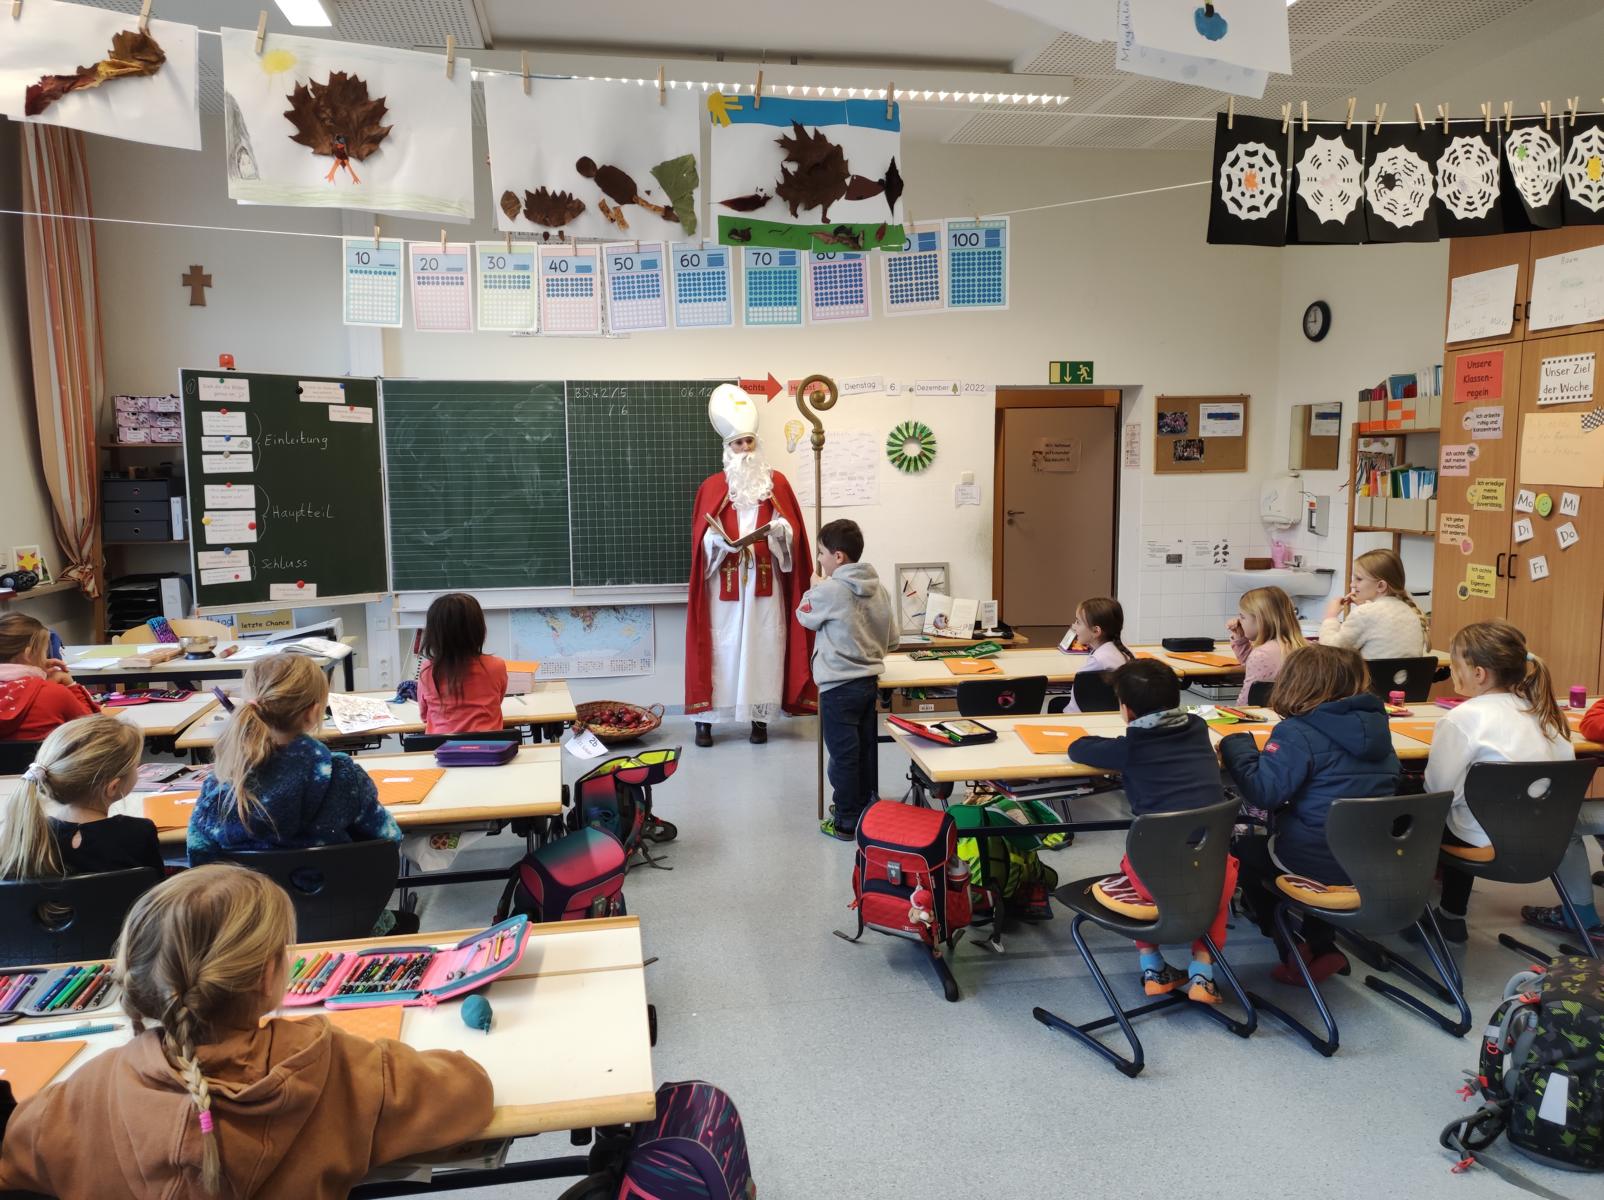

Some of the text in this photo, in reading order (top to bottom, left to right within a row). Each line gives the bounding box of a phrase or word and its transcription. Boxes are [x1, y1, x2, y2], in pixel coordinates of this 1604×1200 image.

[952, 232, 980, 248] 100
[355, 251, 370, 265] 10
[420, 258, 438, 271] 20
[488, 256, 506, 270] 30
[614, 257, 634, 271] 50
[680, 254, 700, 267] 60
[752, 252, 772, 266] 70
[549, 259, 569, 273] 40
[1467, 360, 1492, 369] Unsere
[1545, 363, 1591, 377] Unser Ziel
[1463, 374, 1494, 383] Klassen-
[844, 382, 876, 391] Dienstag
[889, 383, 895, 391] 6
[964, 383, 985, 392] 2022
[1543, 382, 1590, 394] der Woche
[264, 433, 328, 450] Einleitung
[1517, 495, 1533, 508] Mo
[1563, 500, 1577, 511] Mi
[272, 504, 333, 522] Hauptteil
[1518, 525, 1530, 536] Di
[1560, 529, 1575, 539] Do
[261, 555, 308, 569] Schluss
[1533, 563, 1545, 574] Fr
[241, 621, 263, 629] letzte
